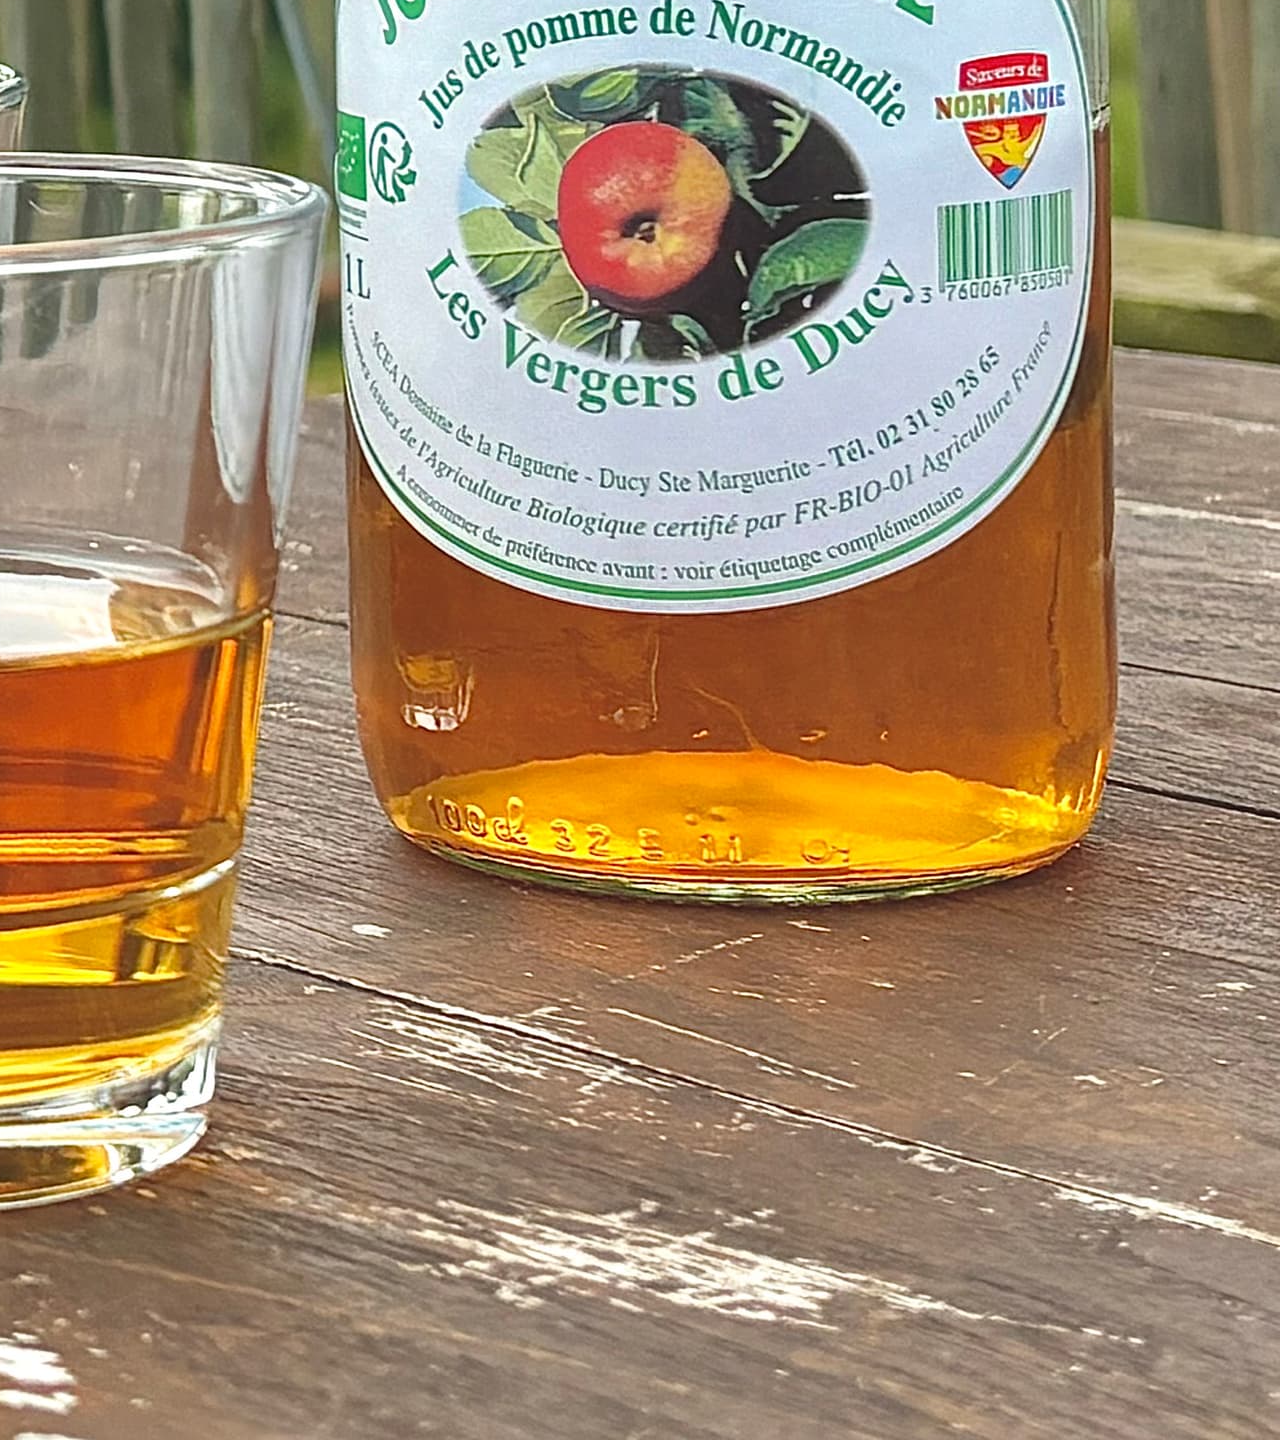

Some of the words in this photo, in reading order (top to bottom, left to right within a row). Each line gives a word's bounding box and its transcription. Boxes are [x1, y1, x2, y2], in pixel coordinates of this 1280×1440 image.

[418, 69, 464, 130] Jus
[463, 40, 501, 79] de
[502, 5, 638, 68] pomme
[705, 0, 907, 128] Normandie
[934, 83, 1067, 120] NORMANDIE
[345, 252, 371, 300] 1L
[425, 248, 488, 340] Les
[502, 317, 698, 414] Vergers
[717, 352, 785, 401] de
[787, 258, 915, 376] Ducy
[399, 426, 417, 449] de
[417, 440, 522, 512] l'Agriculture
[526, 497, 648, 539] Biologique
[653, 513, 739, 541] certifié
[744, 512, 788, 539] par
[794, 463, 914, 525] FR-BIO-01
[921, 389, 1014, 478] Agriculture
[476, 433, 491, 457] la
[600, 467, 651, 497] Ducy
[658, 471, 692, 493] Ste
[697, 459, 812, 493] Marguerite
[828, 437, 875, 468] Tél.
[876, 423, 904, 449] 02
[904, 408, 931, 436] 31
[931, 389, 956, 417] 80
[956, 368, 980, 398] 28
[979, 345, 1001, 374] 65
[482, 526, 503, 548] de
[602, 560, 656, 580] avant
[673, 561, 715, 581] voir
[719, 548, 822, 581] étiquetage
[826, 485, 965, 559] complémentaire
